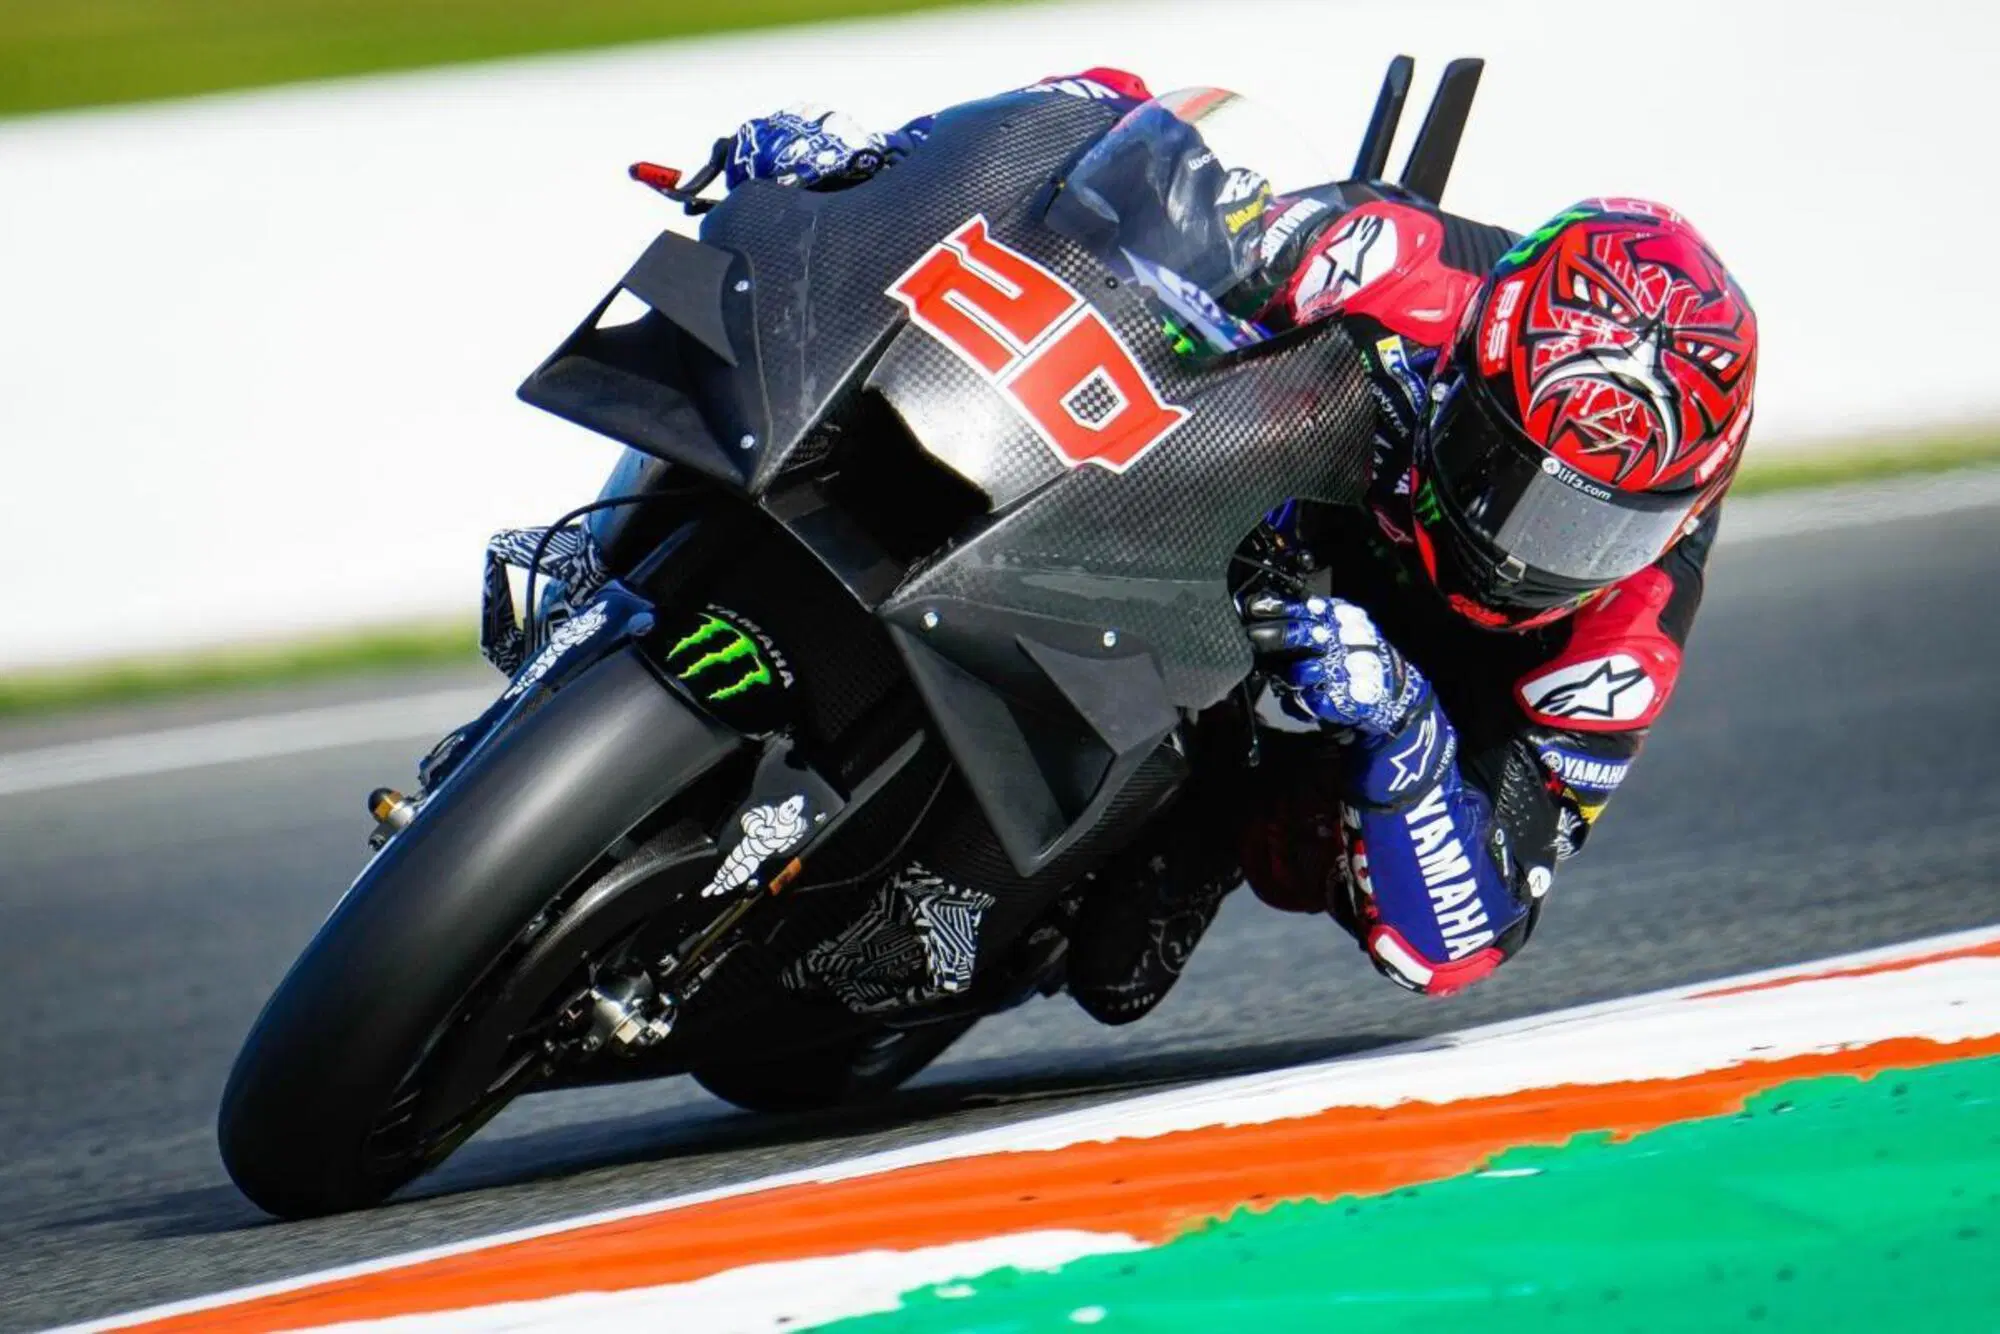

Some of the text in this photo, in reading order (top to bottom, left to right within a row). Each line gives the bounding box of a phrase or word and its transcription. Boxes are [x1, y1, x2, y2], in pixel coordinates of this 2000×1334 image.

[884, 213, 1194, 475] 20
[1558, 467, 1612, 501] lif3.com
[1405, 784, 1494, 961] YAMAHA
